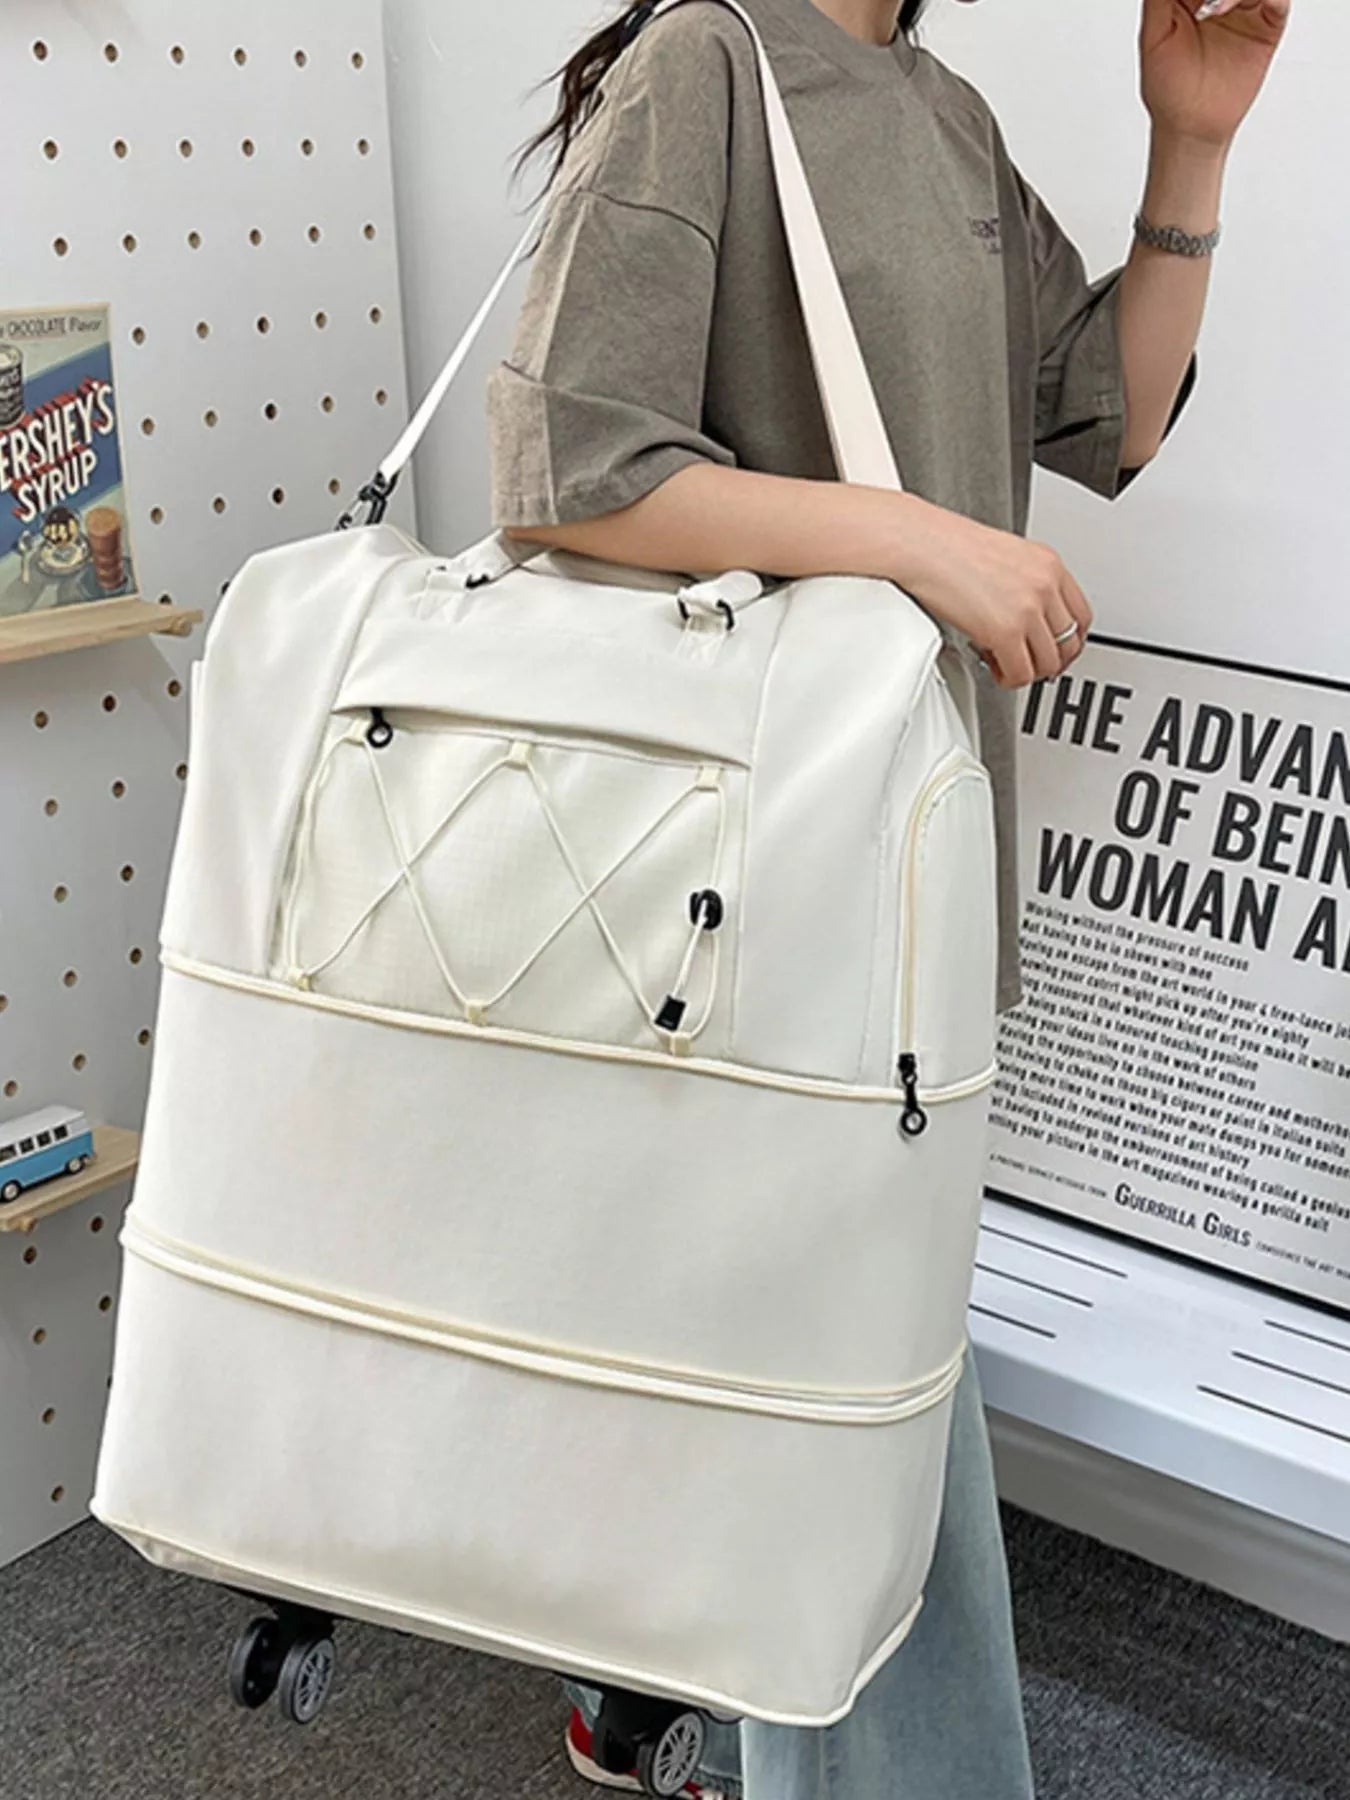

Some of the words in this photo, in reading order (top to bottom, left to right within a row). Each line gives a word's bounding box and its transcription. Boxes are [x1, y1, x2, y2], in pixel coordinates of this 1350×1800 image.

[9, 316, 66, 336] CHOCOLATE
[18, 449, 97, 523] SYRUP
[1021, 676, 1133, 754] THE
[1114, 769, 1200, 847] OF
[1037, 828, 1281, 952] WOMAN
[1293, 898, 1350, 977] A
[1059, 968, 1085, 983] your
[1111, 961, 1138, 980] from
[1229, 996, 1257, 1012] your
[1311, 1059, 1335, 1074] will
[1159, 1111, 1186, 1127] your
